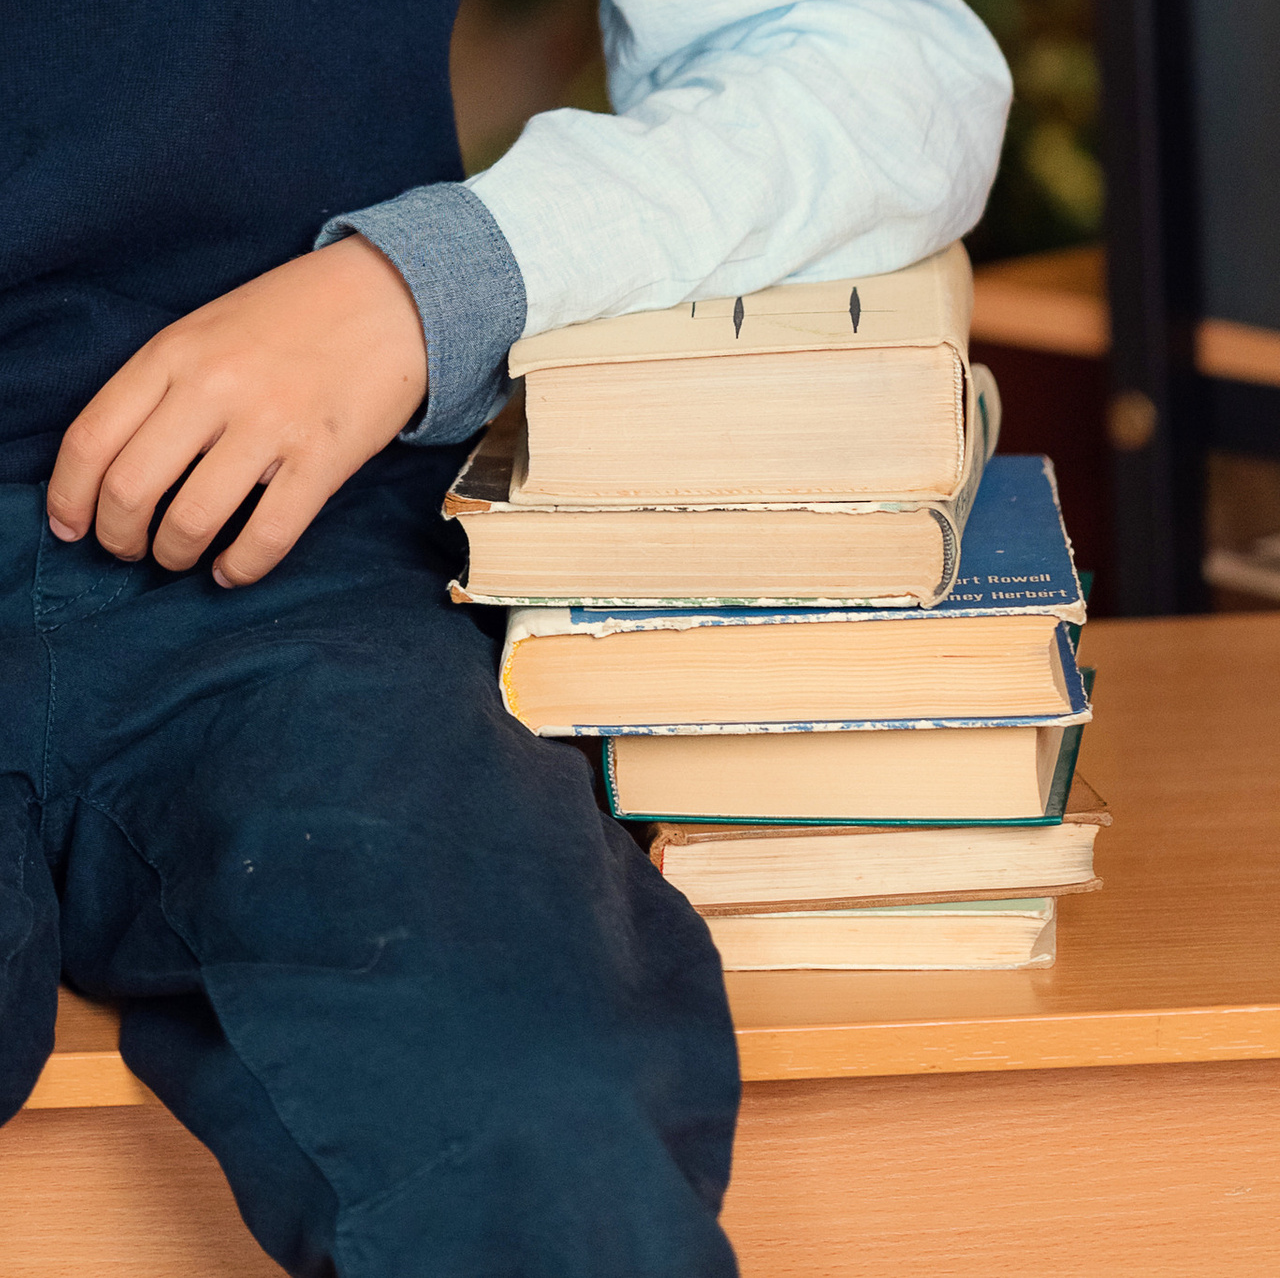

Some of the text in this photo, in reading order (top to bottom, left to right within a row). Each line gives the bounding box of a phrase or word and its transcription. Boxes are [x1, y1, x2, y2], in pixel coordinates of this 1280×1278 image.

[987, 573, 1051, 584] Rowell
[948, 589, 1068, 602] ney Herbert
